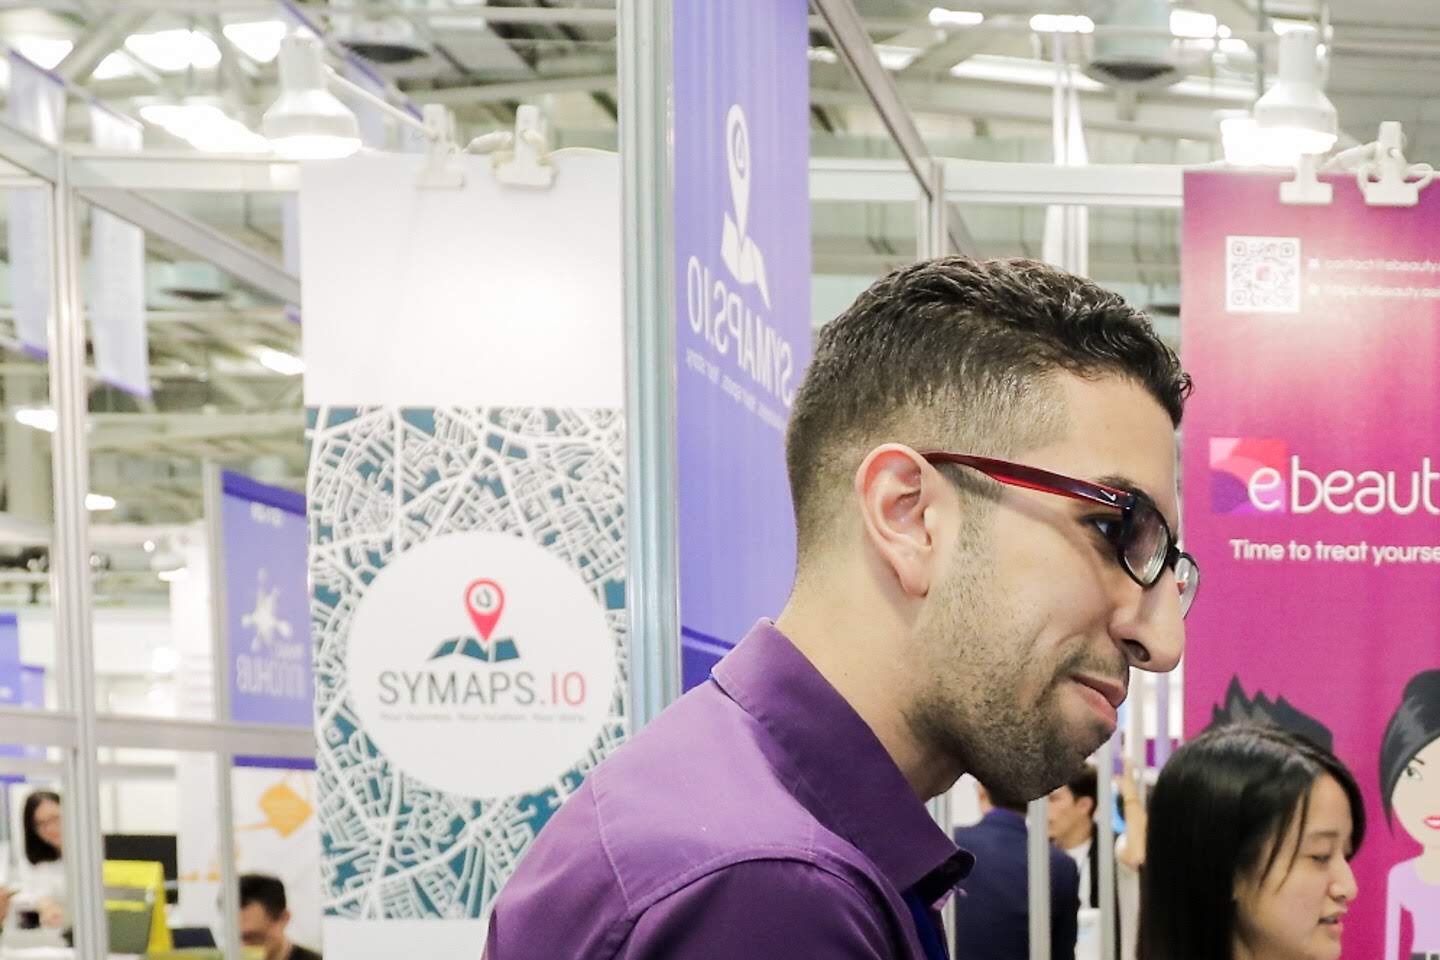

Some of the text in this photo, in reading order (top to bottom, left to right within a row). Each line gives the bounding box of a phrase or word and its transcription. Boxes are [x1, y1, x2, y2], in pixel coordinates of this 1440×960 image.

[1230, 539, 1284, 561] Time
[1288, 540, 1312, 561] to
[1315, 541, 1368, 562] treat
[378, 671, 587, 706] SYMAPS.IO
